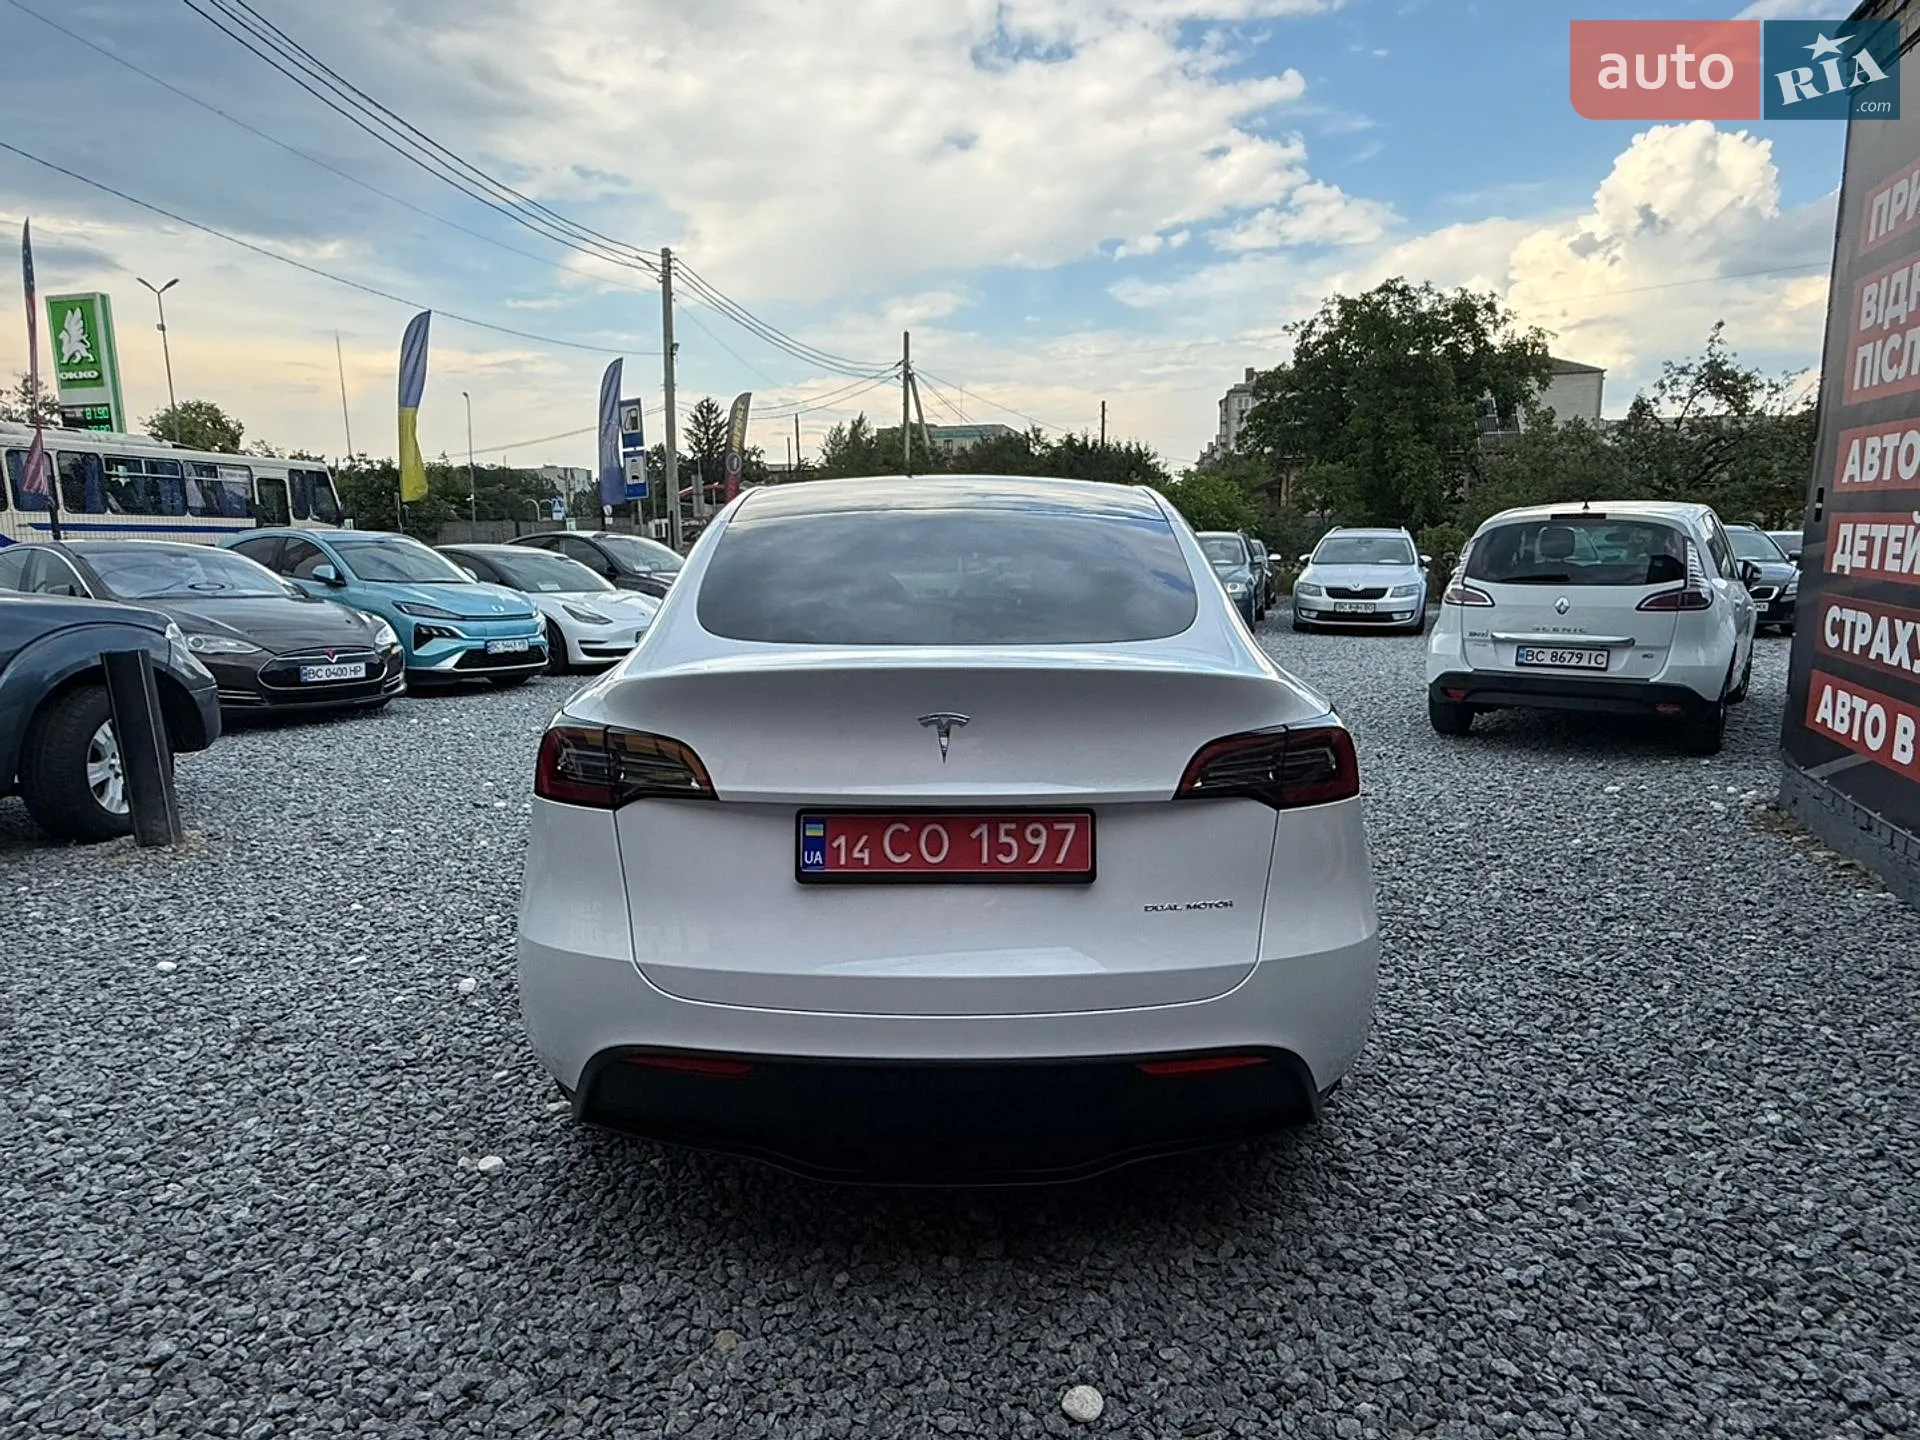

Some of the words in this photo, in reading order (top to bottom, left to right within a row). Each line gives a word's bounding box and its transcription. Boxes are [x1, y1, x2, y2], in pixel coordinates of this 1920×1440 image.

[1841, 429, 1920, 484] АВТО
[1525, 650, 1546, 663] BC
[1550, 650, 1583, 665] 8679
[1588, 652, 1606, 666] IC
[307, 667, 323, 679] BC
[325, 666, 347, 678] 0400
[1815, 684, 1887, 752] АВТО
[1892, 713, 1916, 766] В
[831, 835, 870, 866] 14
[882, 823, 950, 865] CO
[969, 822, 1077, 865] 1597
[804, 851, 823, 865] UA
[1143, 903, 1182, 912] DUAL
[1186, 899, 1233, 910] MOTOR
